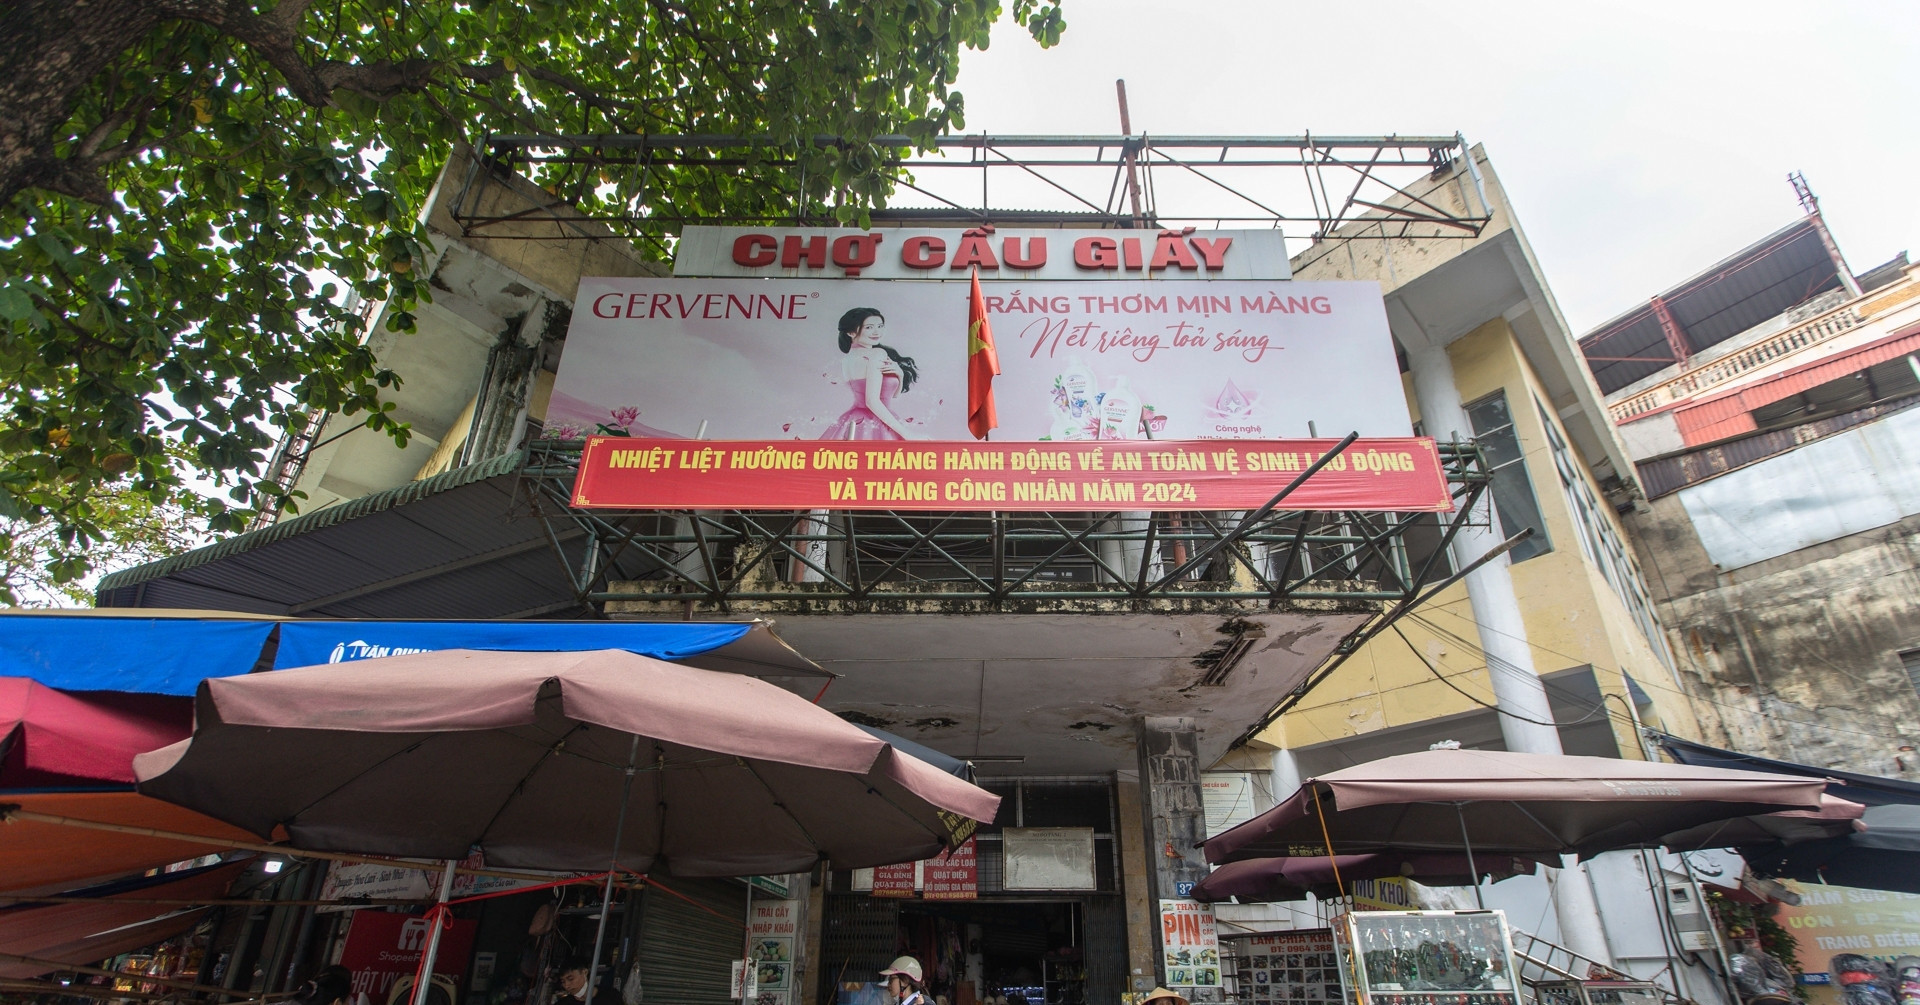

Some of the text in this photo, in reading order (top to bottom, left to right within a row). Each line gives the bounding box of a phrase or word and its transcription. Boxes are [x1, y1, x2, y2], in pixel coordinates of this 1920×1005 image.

[732, 224, 1233, 276] CHỢ CẦU GIẤY
[966, 289, 1332, 318] RẮNG THƠM MỊN MÀNG
[1020, 316, 1100, 358] Nét
[1092, 326, 1169, 362] riêng
[1213, 325, 1285, 362] sáng
[1215, 425, 1261, 434] Công nghệ
[609, 446, 675, 473] NHIỆT
[679, 446, 726, 473] LIỆT
[730, 445, 807, 470] HƯỞNG
[812, 446, 859, 470] ỨNG
[864, 446, 937, 470] THÁNG
[943, 447, 1004, 470] HÀNH
[1011, 448, 1072, 476] ĐỘNG
[1078, 445, 1105, 471] VỀ
[1112, 451, 1142, 471] AN
[1147, 446, 1208, 471] TOÀN
[1213, 448, 1240, 476] VỆ
[1245, 451, 1297, 472] SINH
[1353, 449, 1415, 476] ĐỘNG
[828, 476, 1197, 502] VÀ THÁNG CÔNG NHÂN NĂM 2024
[360, 645, 390, 658] VĂN
[392, 647, 434, 657] QU
[933, 871, 950, 880] QUẠT
[874, 881, 895, 889] QUẠT
[1179, 883, 1193, 895] 37
[757, 906, 790, 918] TRÁI CÂY
[1175, 903, 1199, 911] THAY
[752, 920, 794, 935] NHẬP KHẨU
[1163, 913, 1201, 946] PIN
[1816, 935, 1872, 950] TRANG
[378, 950, 437, 964] ShopeeF
